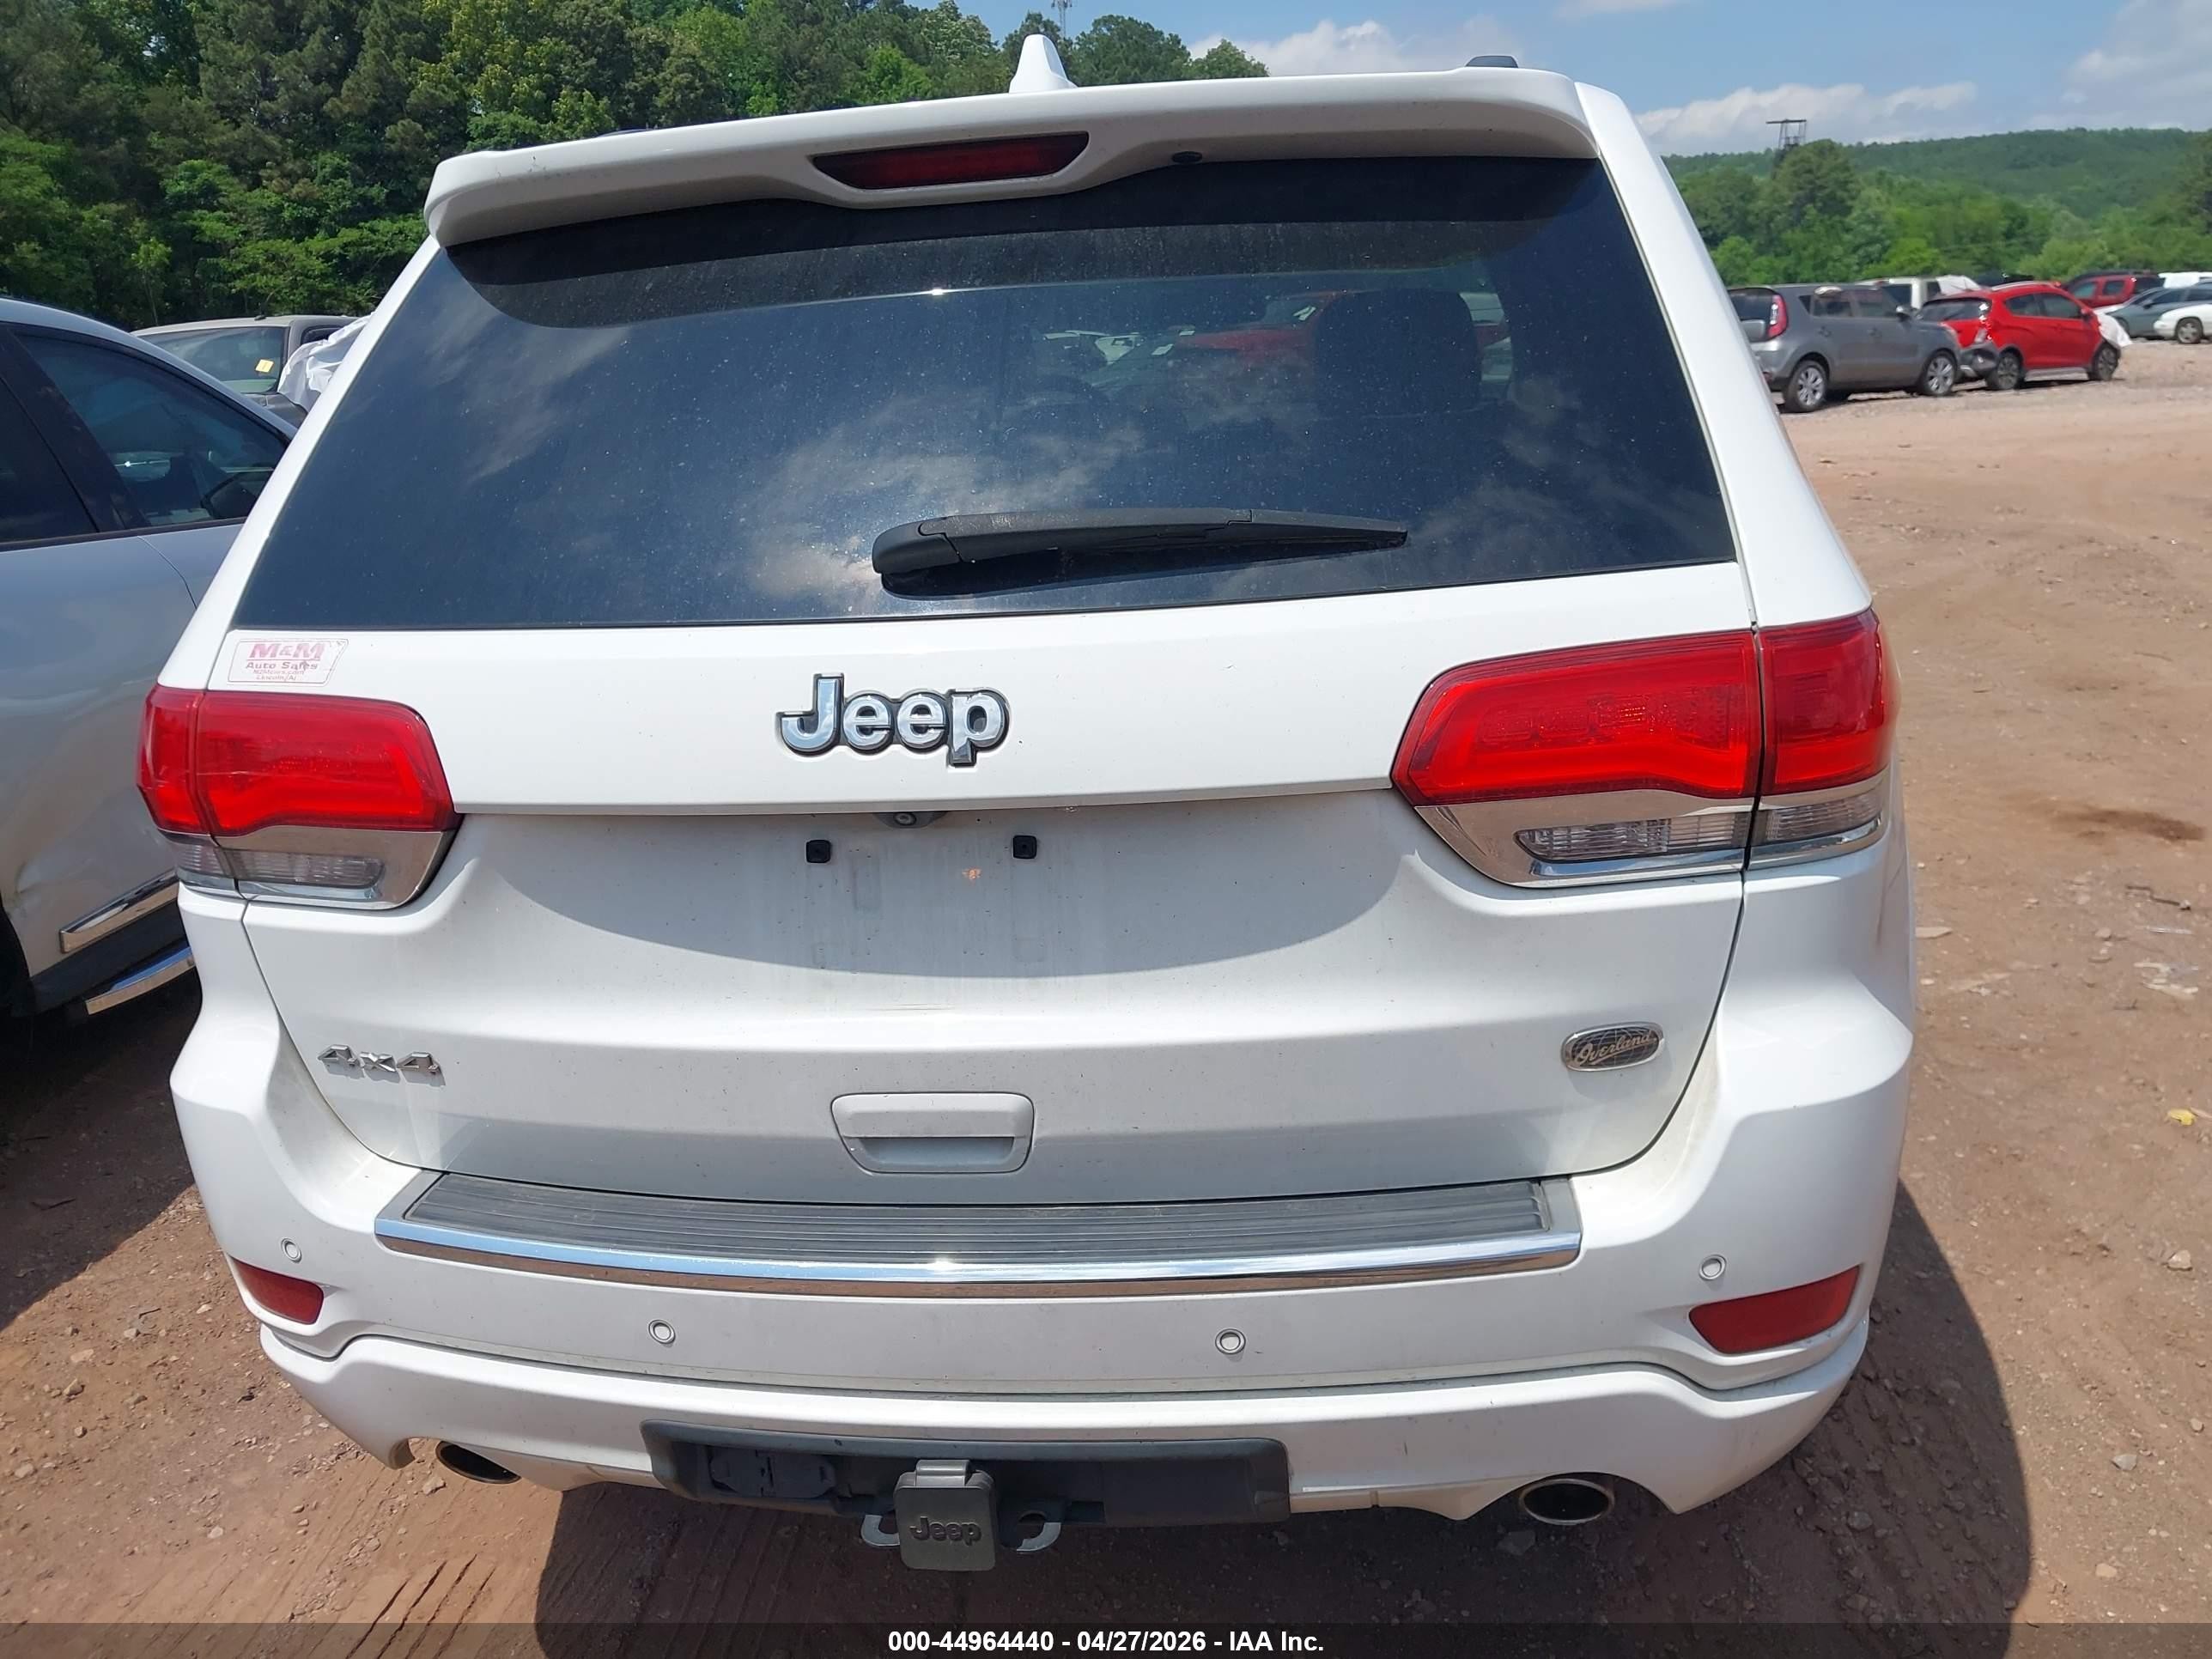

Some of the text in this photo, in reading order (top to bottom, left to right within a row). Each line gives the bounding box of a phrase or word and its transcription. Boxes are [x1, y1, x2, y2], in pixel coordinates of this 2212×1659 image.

[246, 661, 319, 671] Auto Sales
[249, 642, 325, 659] M&M
[775, 672, 1011, 768] Jeep
[1575, 1029, 1658, 1066] Overland
[908, 1516, 982, 1547] Jeep
